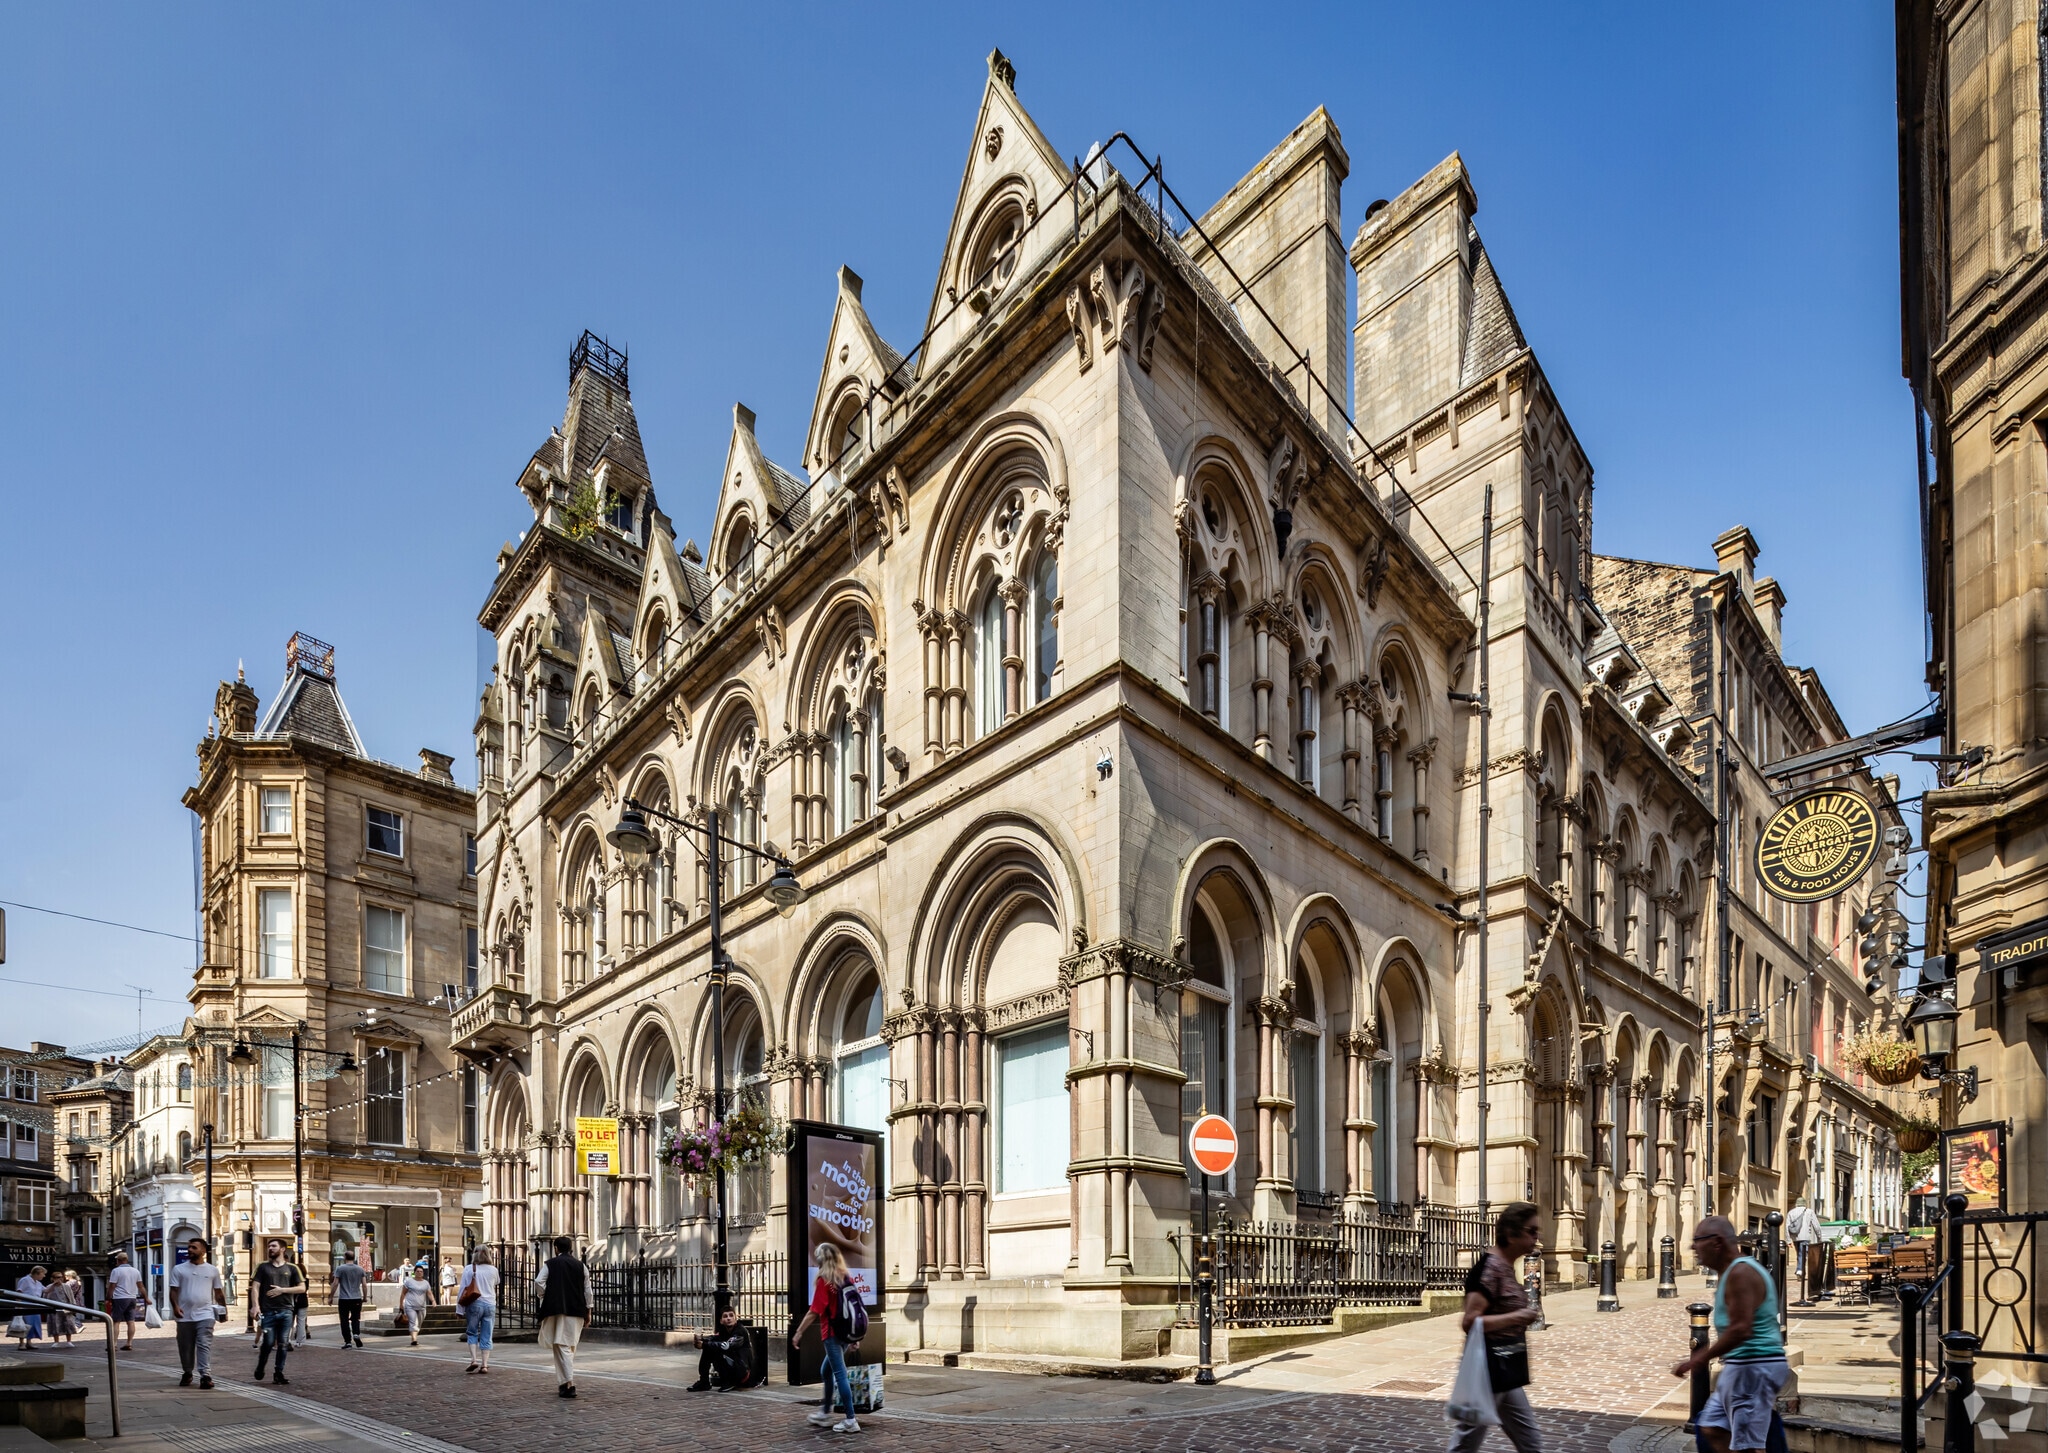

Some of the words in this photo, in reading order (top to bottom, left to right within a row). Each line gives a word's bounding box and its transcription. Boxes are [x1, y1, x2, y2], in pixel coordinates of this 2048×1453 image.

[1767, 806, 1801, 842] CITY
[1805, 796, 1867, 824] VAULTS
[1778, 833, 1855, 858] HUSTLERGATE
[1774, 870, 1792, 886] PUB
[1791, 880, 1799, 888] &
[1801, 877, 1831, 890] FOOD
[1832, 850, 1862, 880] HOUSE
[578, 1130, 593, 1140] TO
[597, 1130, 617, 1140] LET
[820, 1160, 871, 1202] mood
[843, 1160, 852, 1174] In
[852, 1169, 866, 1187] the
[835, 1200, 858, 1215] some
[850, 1196, 863, 1209] for
[809, 1203, 874, 1234] smooth?
[9, 1254, 57, 1262] WINDE
